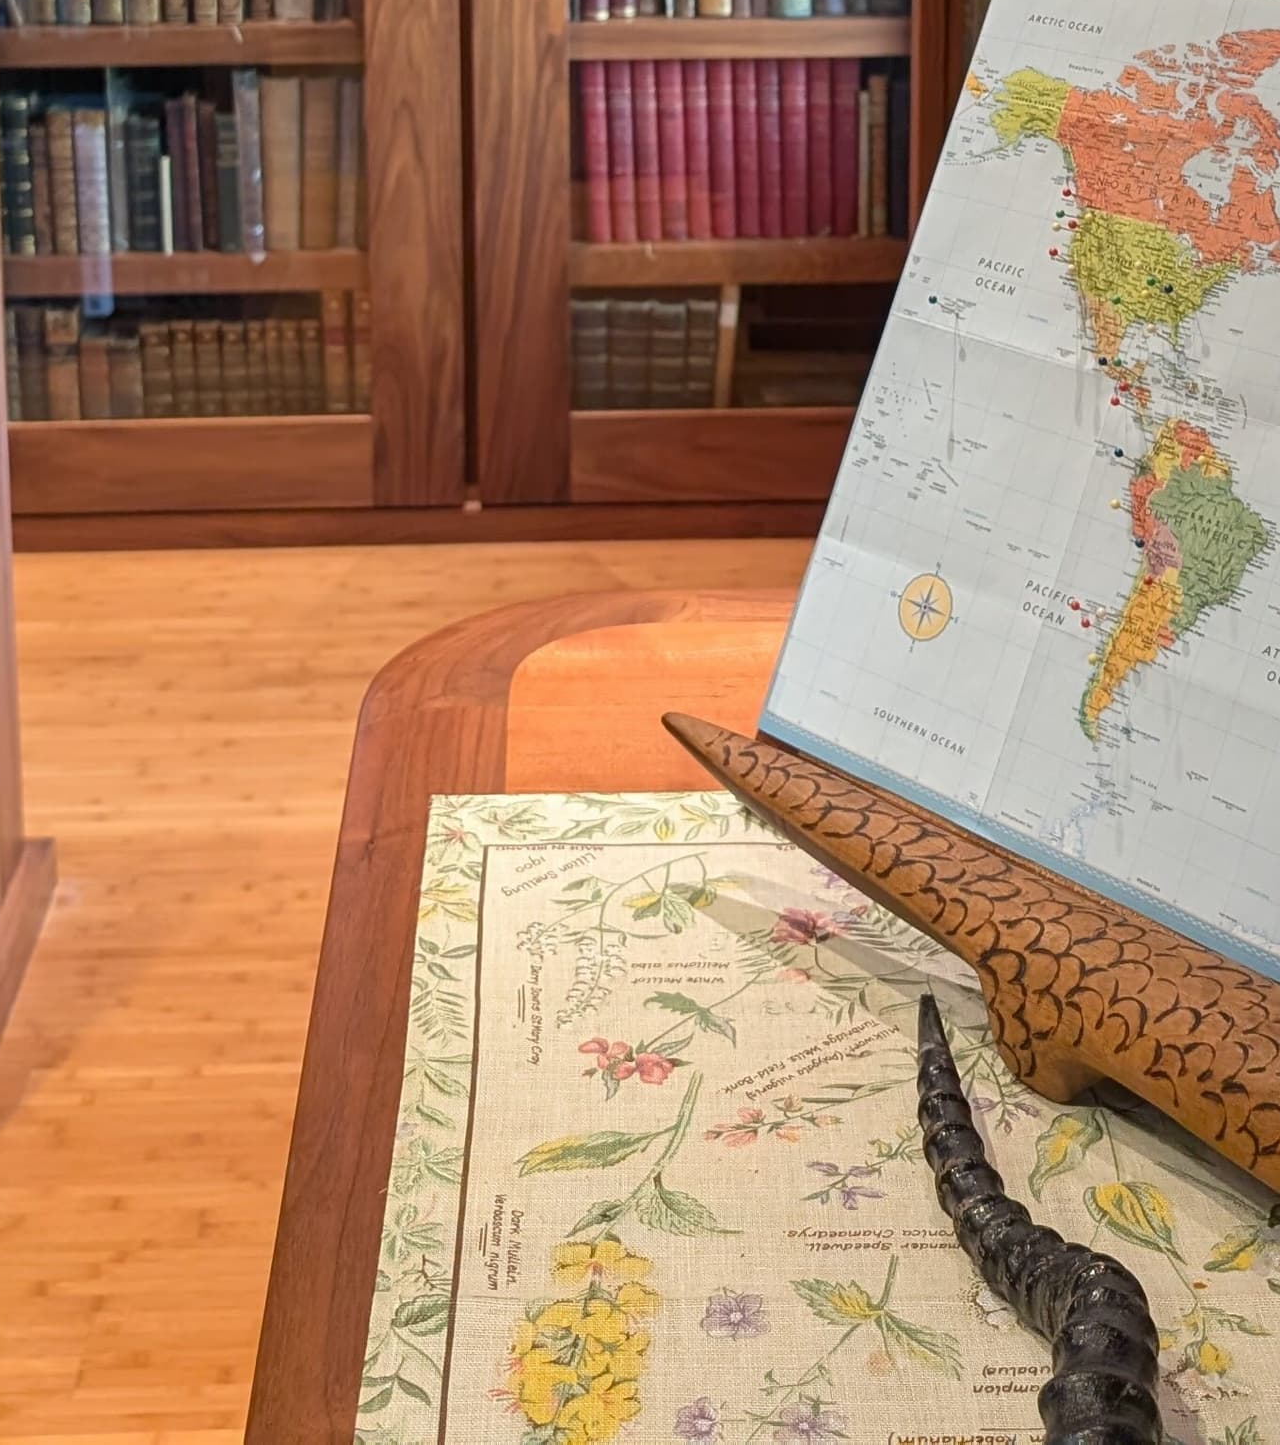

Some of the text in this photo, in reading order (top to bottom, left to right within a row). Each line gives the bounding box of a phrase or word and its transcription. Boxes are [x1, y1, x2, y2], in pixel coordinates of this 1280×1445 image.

[1028, 14, 1104, 35] ARCTIC OCEAN
[1171, 193, 1258, 222] AMERICA
[977, 256, 1025, 279] PACIFIC
[975, 276, 1017, 297] OCEAN
[1188, 523, 1257, 553] AMERICA
[1025, 579, 1075, 607] PACIFIC
[1022, 601, 1066, 626] OCEAN
[872, 706, 967, 755] SOUTHERN OCEAN
[515, 855, 547, 874] 1900
[501, 866, 559, 897] Snelling
[630, 961, 662, 969] alba
[686, 976, 724, 984] White
[510, 1209, 524, 1235] Dark
[782, 1226, 955, 1240] ronica Chamaedrys.
[488, 1193, 507, 1291] Verbascum nigrum
[805, 1240, 961, 1252] mander Speedwell.
[973, 1381, 1040, 1394] ampion
